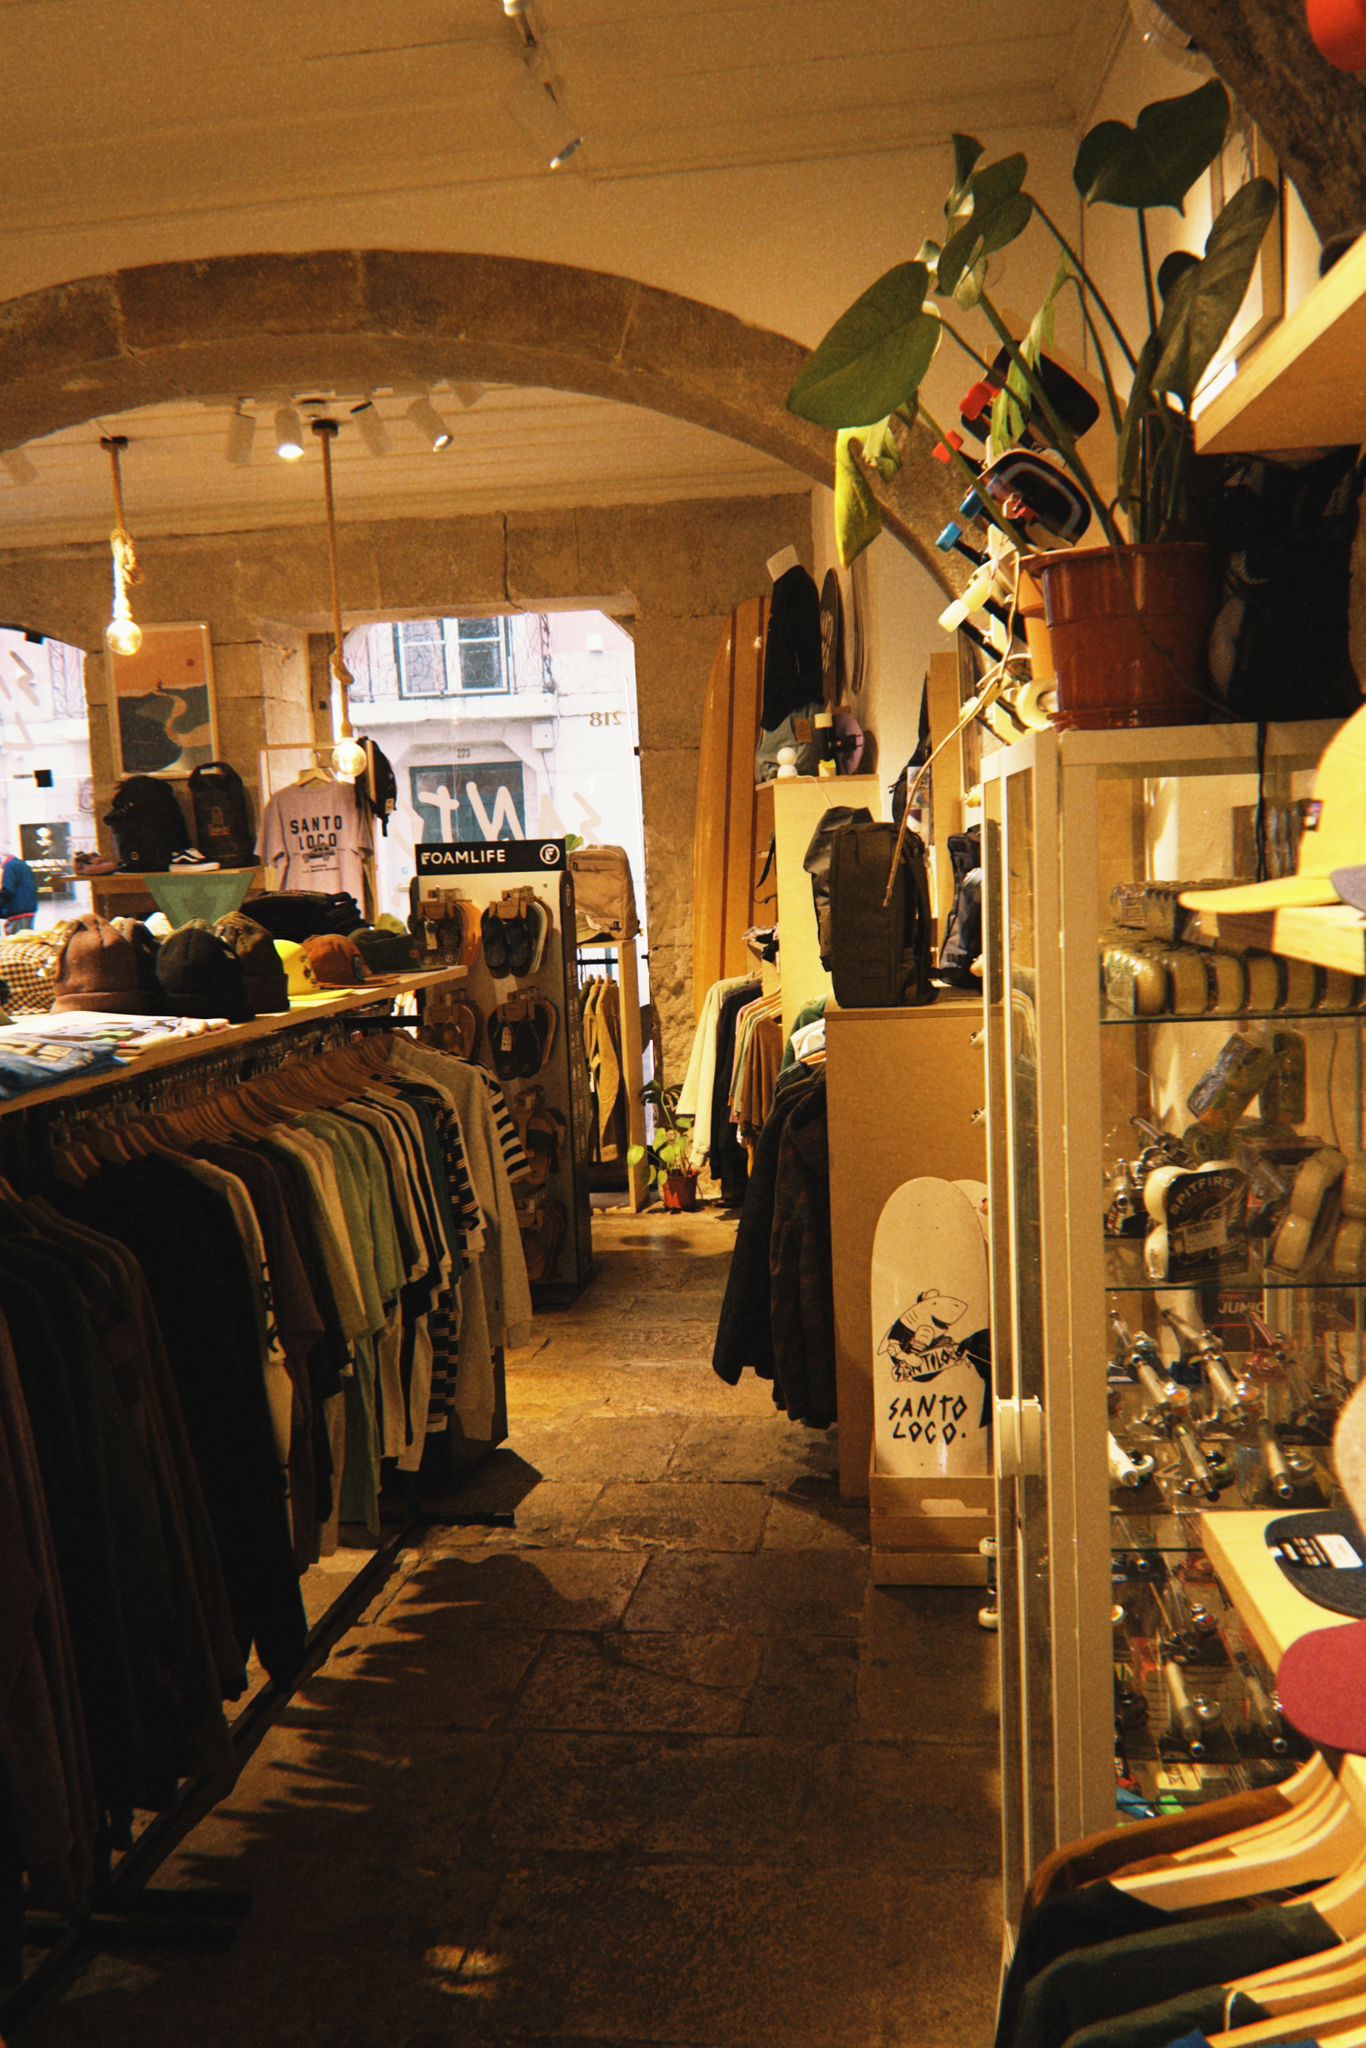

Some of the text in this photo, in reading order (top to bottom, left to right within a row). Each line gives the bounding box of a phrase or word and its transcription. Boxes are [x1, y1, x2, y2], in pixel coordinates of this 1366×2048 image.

[290, 815, 342, 835] SANTO
[420, 849, 506, 865] FOAMLIFE
[1169, 1176, 1234, 1216] SPITFIRE
[888, 1394, 967, 1421] SANTO
[892, 1421, 967, 1445] LOCO.
